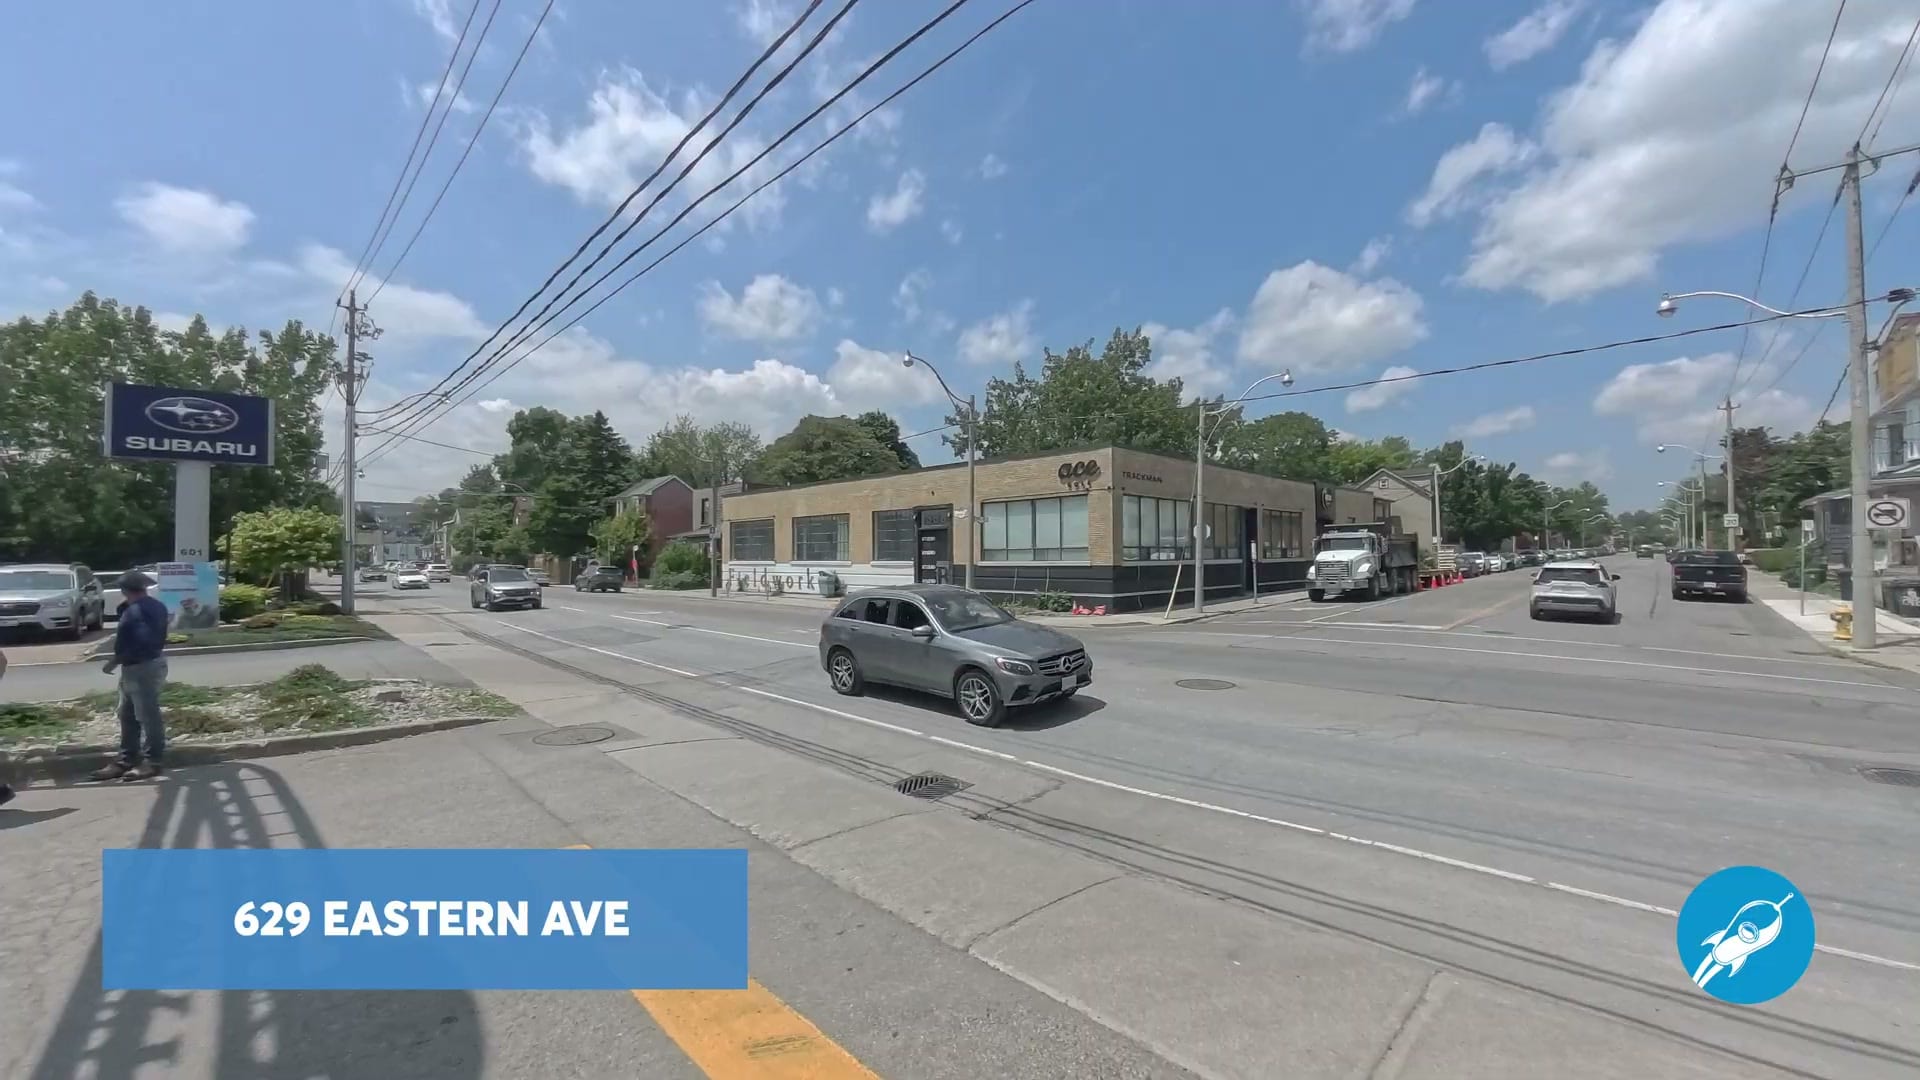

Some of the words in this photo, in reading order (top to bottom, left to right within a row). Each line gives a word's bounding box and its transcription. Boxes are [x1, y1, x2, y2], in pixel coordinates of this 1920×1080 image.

[126, 436, 257, 456] SUBARU
[1058, 460, 1101, 479] ace
[1122, 471, 1163, 483] TRACKMAN
